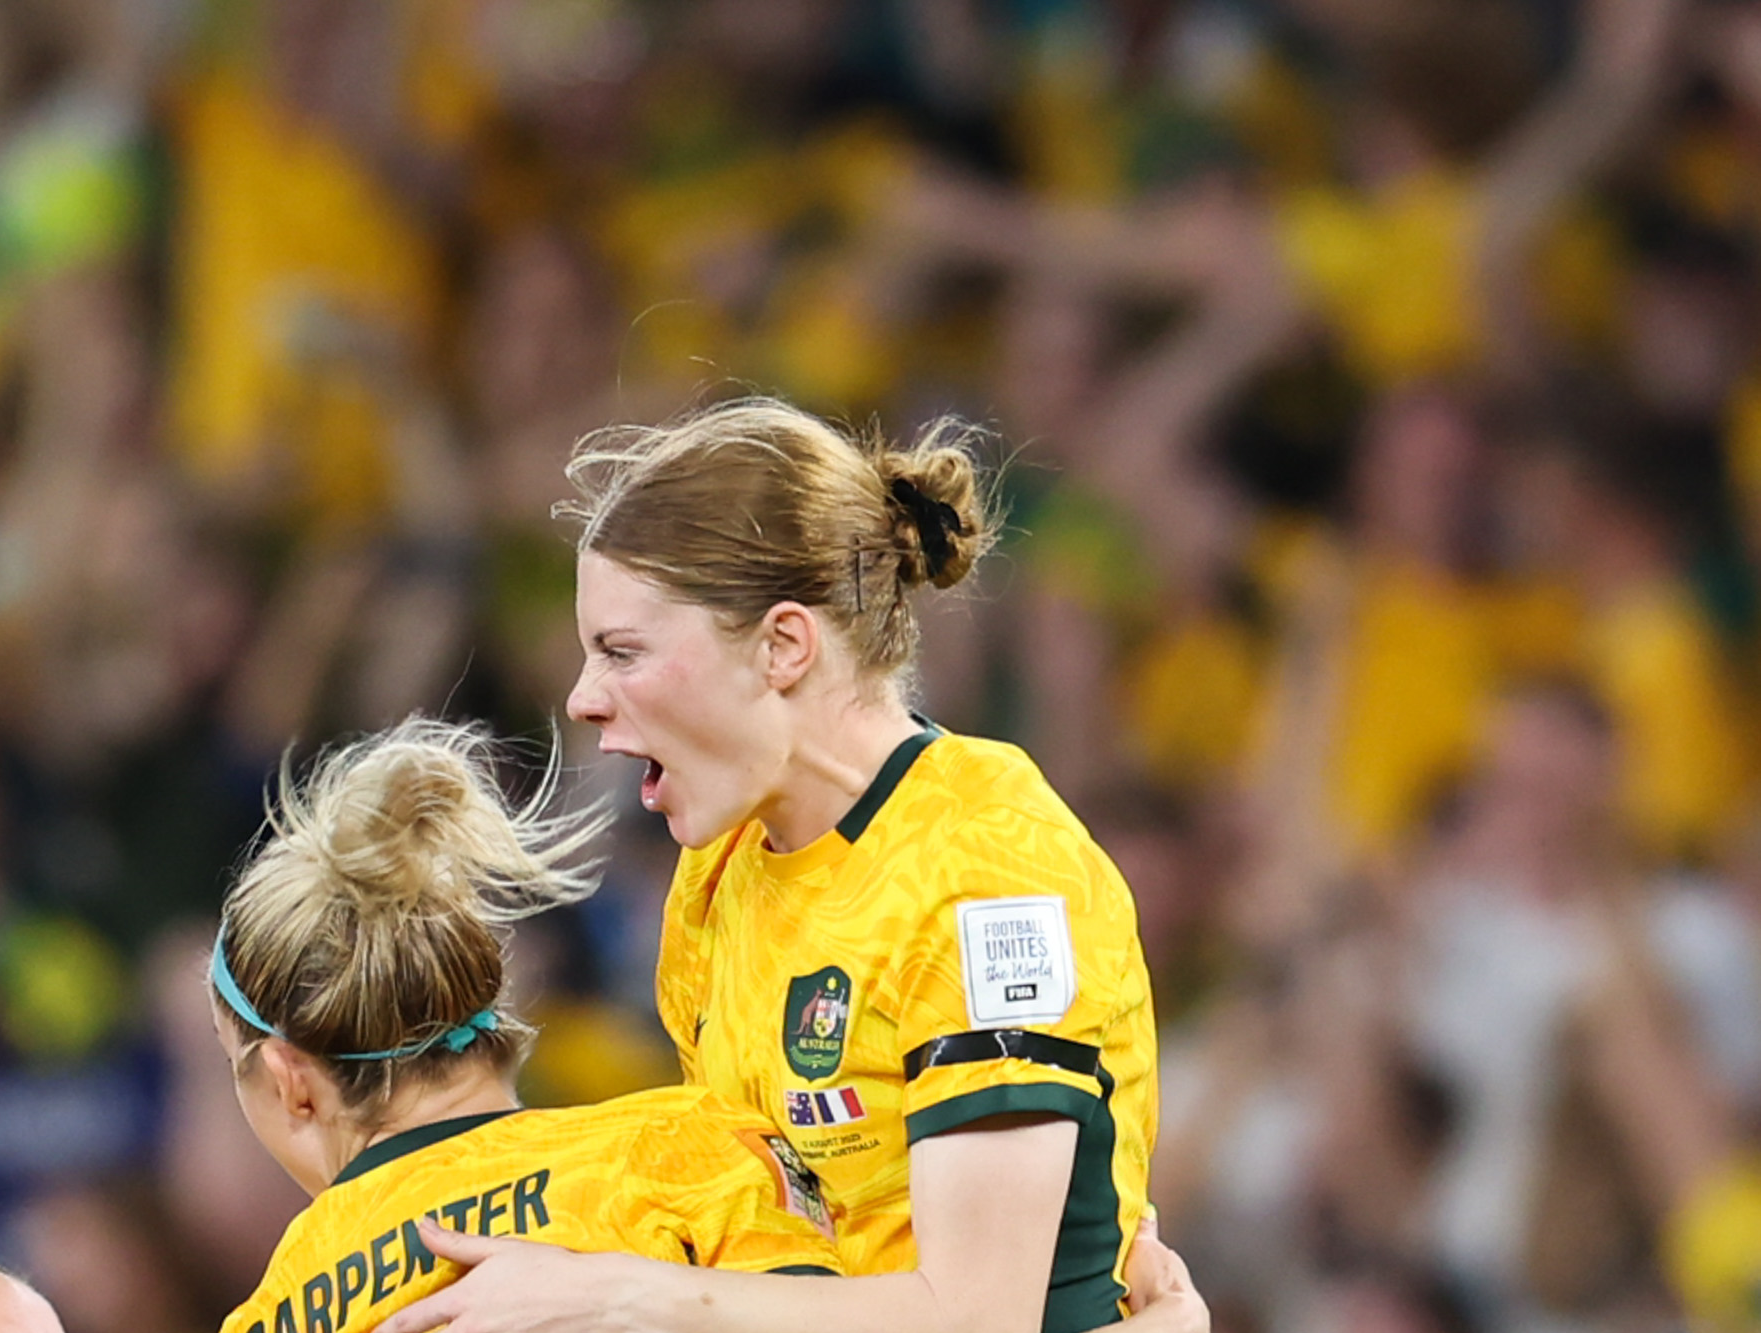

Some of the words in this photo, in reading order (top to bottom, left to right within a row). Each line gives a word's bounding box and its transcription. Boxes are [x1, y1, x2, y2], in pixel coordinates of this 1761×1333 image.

[984, 919, 1045, 938] FOOTBALL
[985, 936, 1048, 961] UNITES
[984, 963, 1009, 983] the
[1007, 985, 1035, 1001] FIFA
